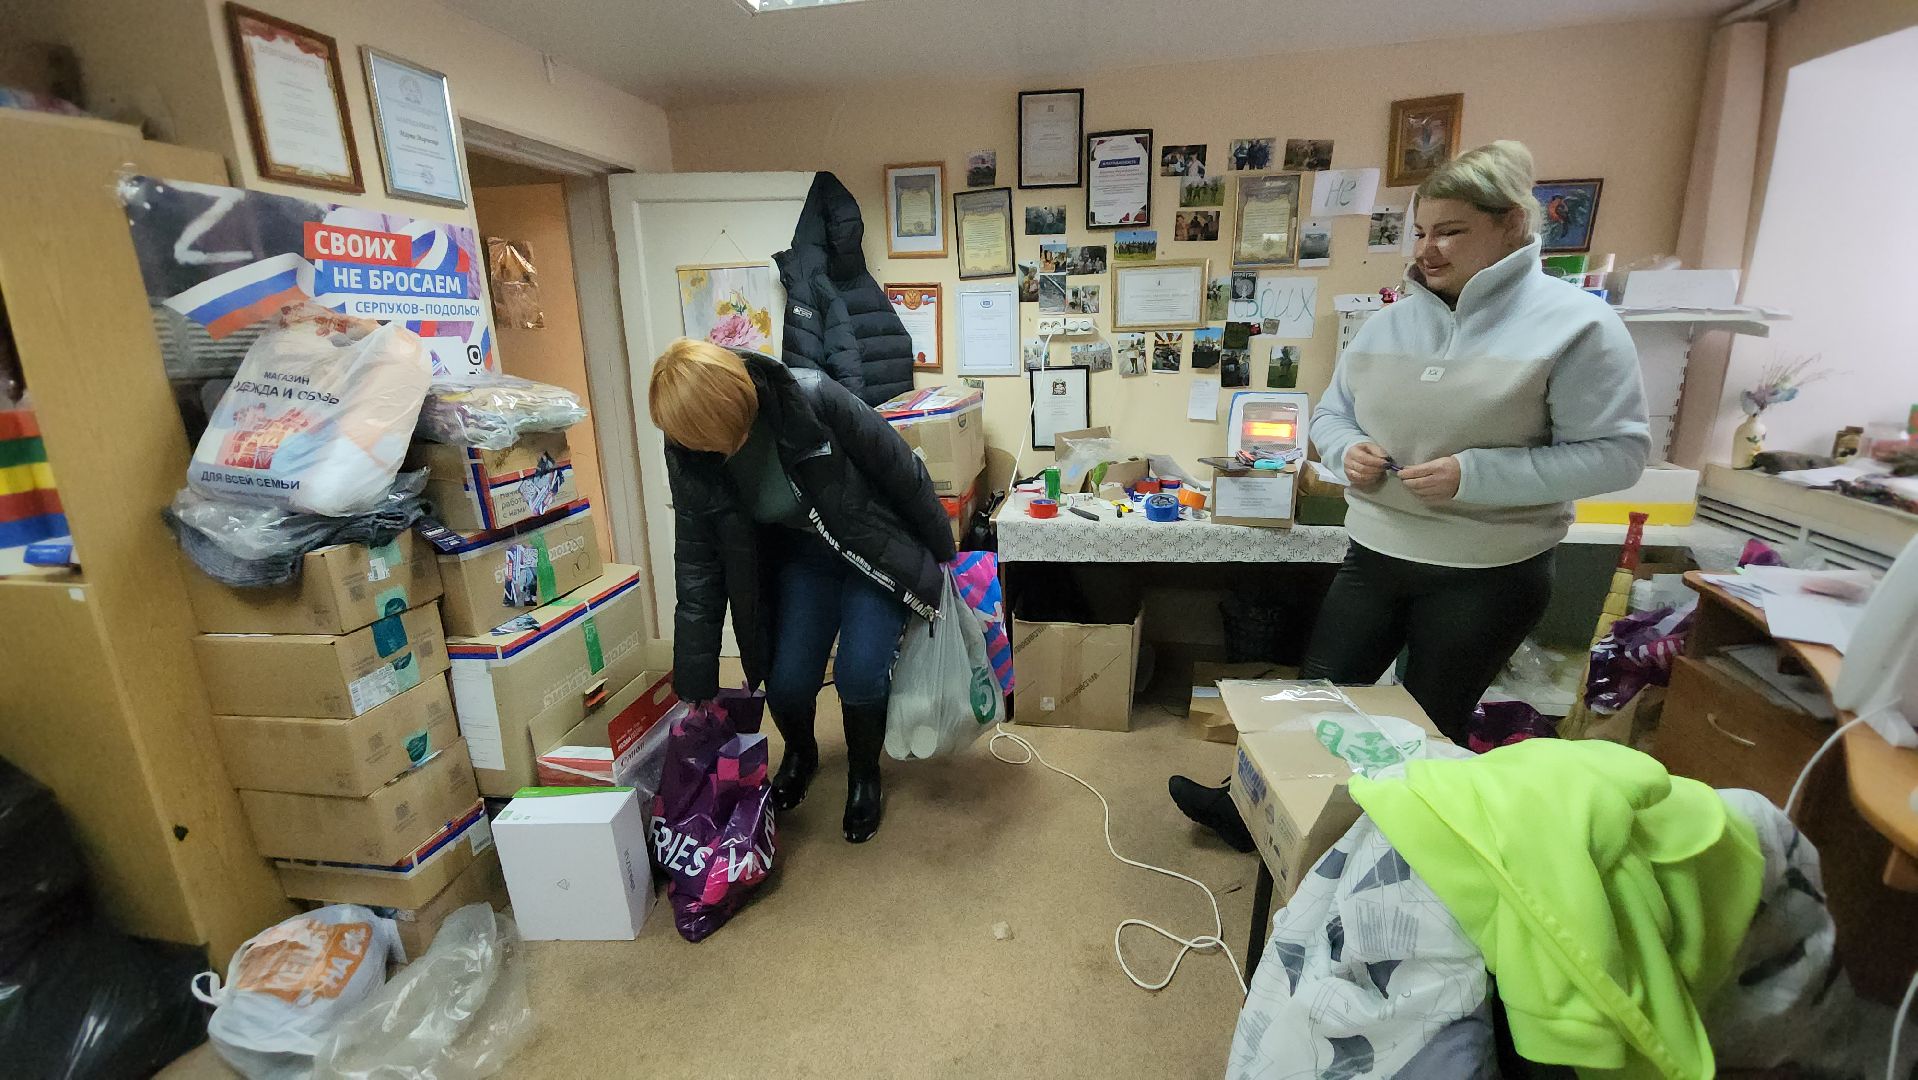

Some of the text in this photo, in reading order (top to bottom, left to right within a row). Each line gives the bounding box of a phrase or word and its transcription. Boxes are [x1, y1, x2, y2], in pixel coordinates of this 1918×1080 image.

[314, 230, 398, 261] СВОИХ
[333, 266, 462, 295] НЕ БРОСАЕМ
[263, 371, 310, 386] МАГАЗИН
[282, 387, 293, 399] И
[201, 471, 300, 490] ДЛЯ ВСЕЙ СЕМЬИ
